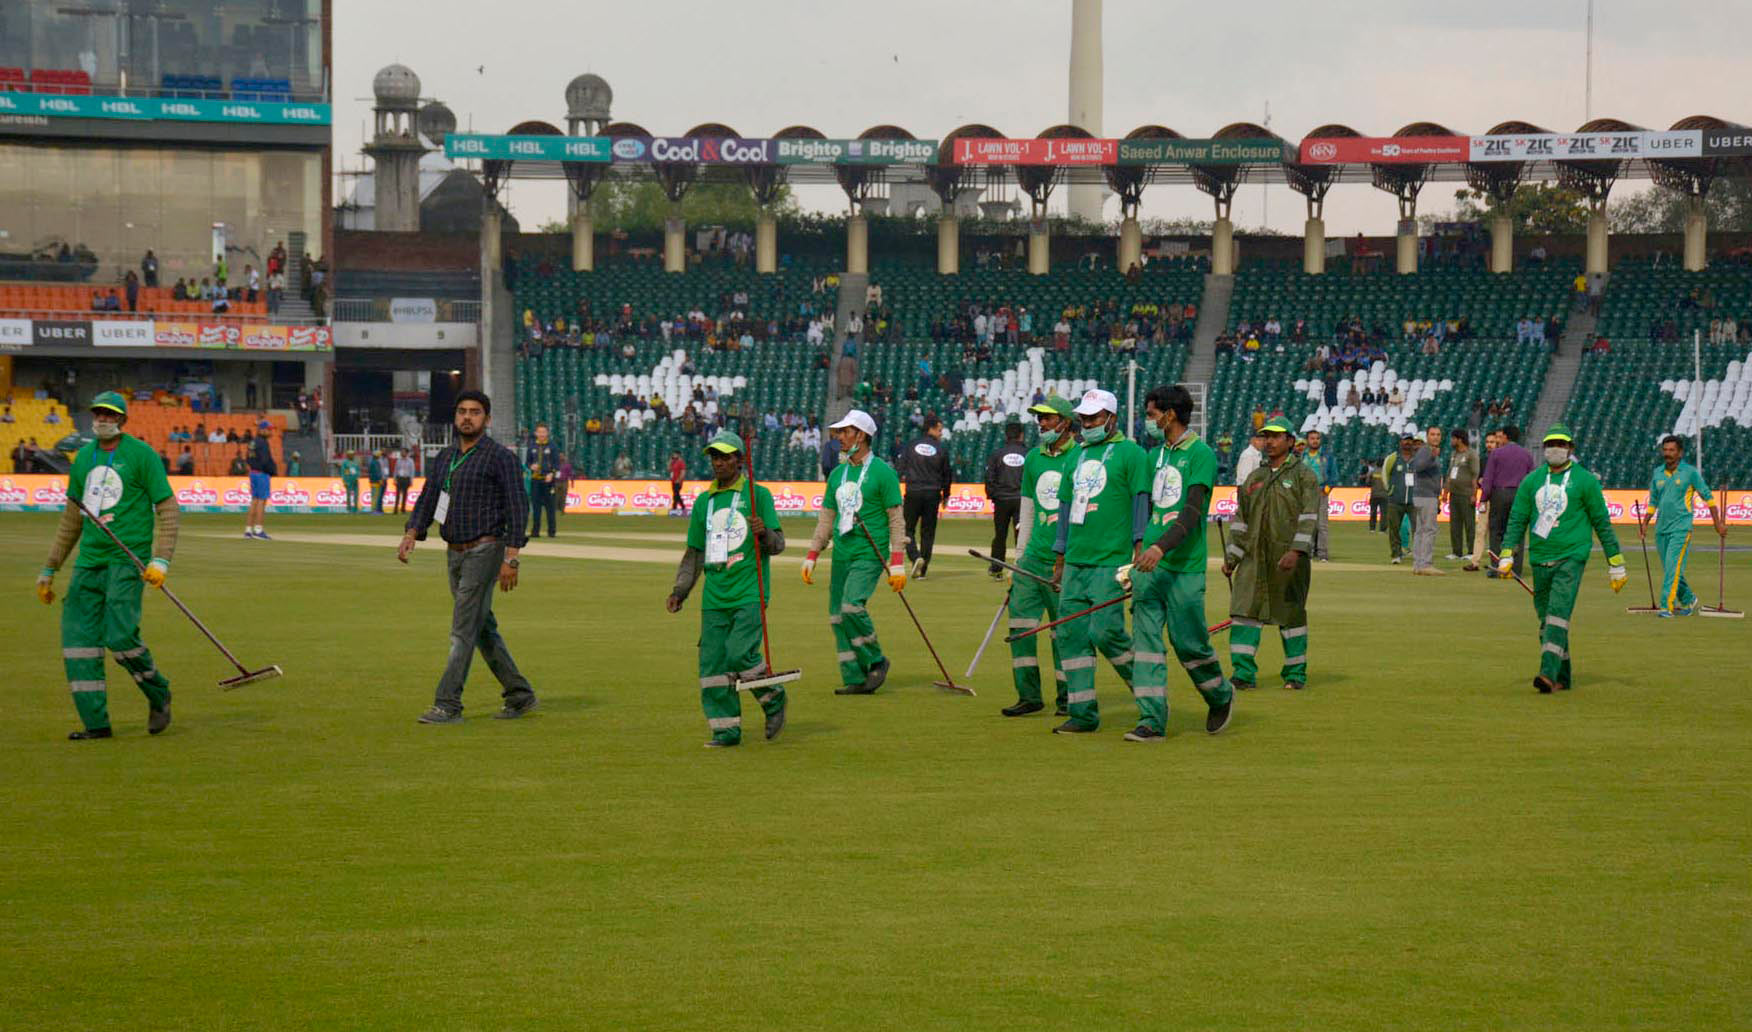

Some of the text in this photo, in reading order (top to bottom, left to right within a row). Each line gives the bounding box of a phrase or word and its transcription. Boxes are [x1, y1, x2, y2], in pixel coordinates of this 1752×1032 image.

[40, 99, 80, 111] HBL
[102, 101, 142, 114] HBL
[161, 103, 202, 115] HBL
[222, 106, 261, 118] HBL
[282, 107, 321, 120] HBL
[453, 140, 490, 153] HBL
[509, 140, 544, 154] HBL
[1485, 139, 1511, 151] ZIC
[1527, 138, 1553, 150] ZIC
[1569, 137, 1595, 149] ZIC
[1612, 136, 1639, 149] ZIC
[1650, 138, 1694, 149] UBER
[1709, 136, 1752, 147] UBER
[565, 142, 601, 156] HBL
[651, 138, 699, 161] Cool
[703, 139, 719, 160] &
[721, 139, 768, 161] Cool
[778, 140, 842, 159] Brighto
[869, 140, 932, 160] Brighto
[961, 141, 974, 161] J.
[978, 143, 1030, 154] LAWN VOL-1
[1044, 141, 1056, 161] J.
[1060, 143, 1113, 154] LAWN VOL-1
[1120, 144, 1280, 159] Saeed Anwar Enclosure
[1382, 144, 1401, 157] 50
[2, 327, 23, 336] ER
[38, 327, 86, 339] UBER
[101, 328, 147, 338] UBER
[588, 495, 625, 508] Giggly
[633, 495, 670, 508] Giggly
[947, 497, 984, 510] Giggly
[1216, 501, 1238, 513] Gig
[1328, 502, 1344, 514] gly
[1352, 502, 1371, 514] Gig
